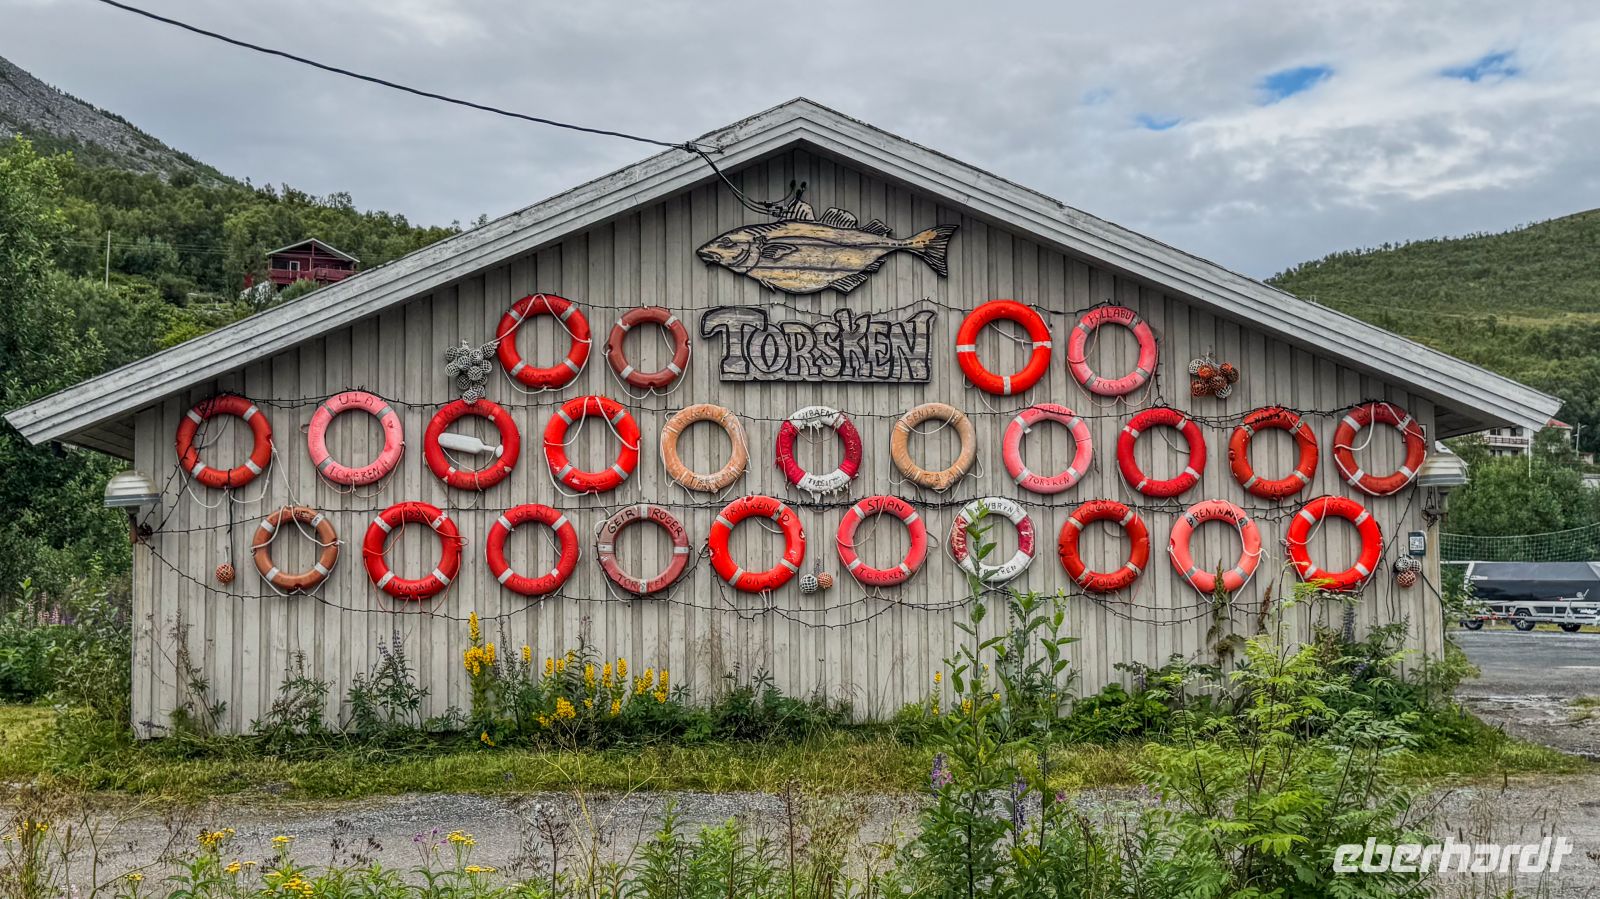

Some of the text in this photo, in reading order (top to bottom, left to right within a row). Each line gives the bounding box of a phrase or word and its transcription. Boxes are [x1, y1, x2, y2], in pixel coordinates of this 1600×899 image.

[702, 307, 936, 380] TORSKEN
[607, 509, 684, 536] GEIR ROGER
[618, 573, 667, 591] TORSKEN
